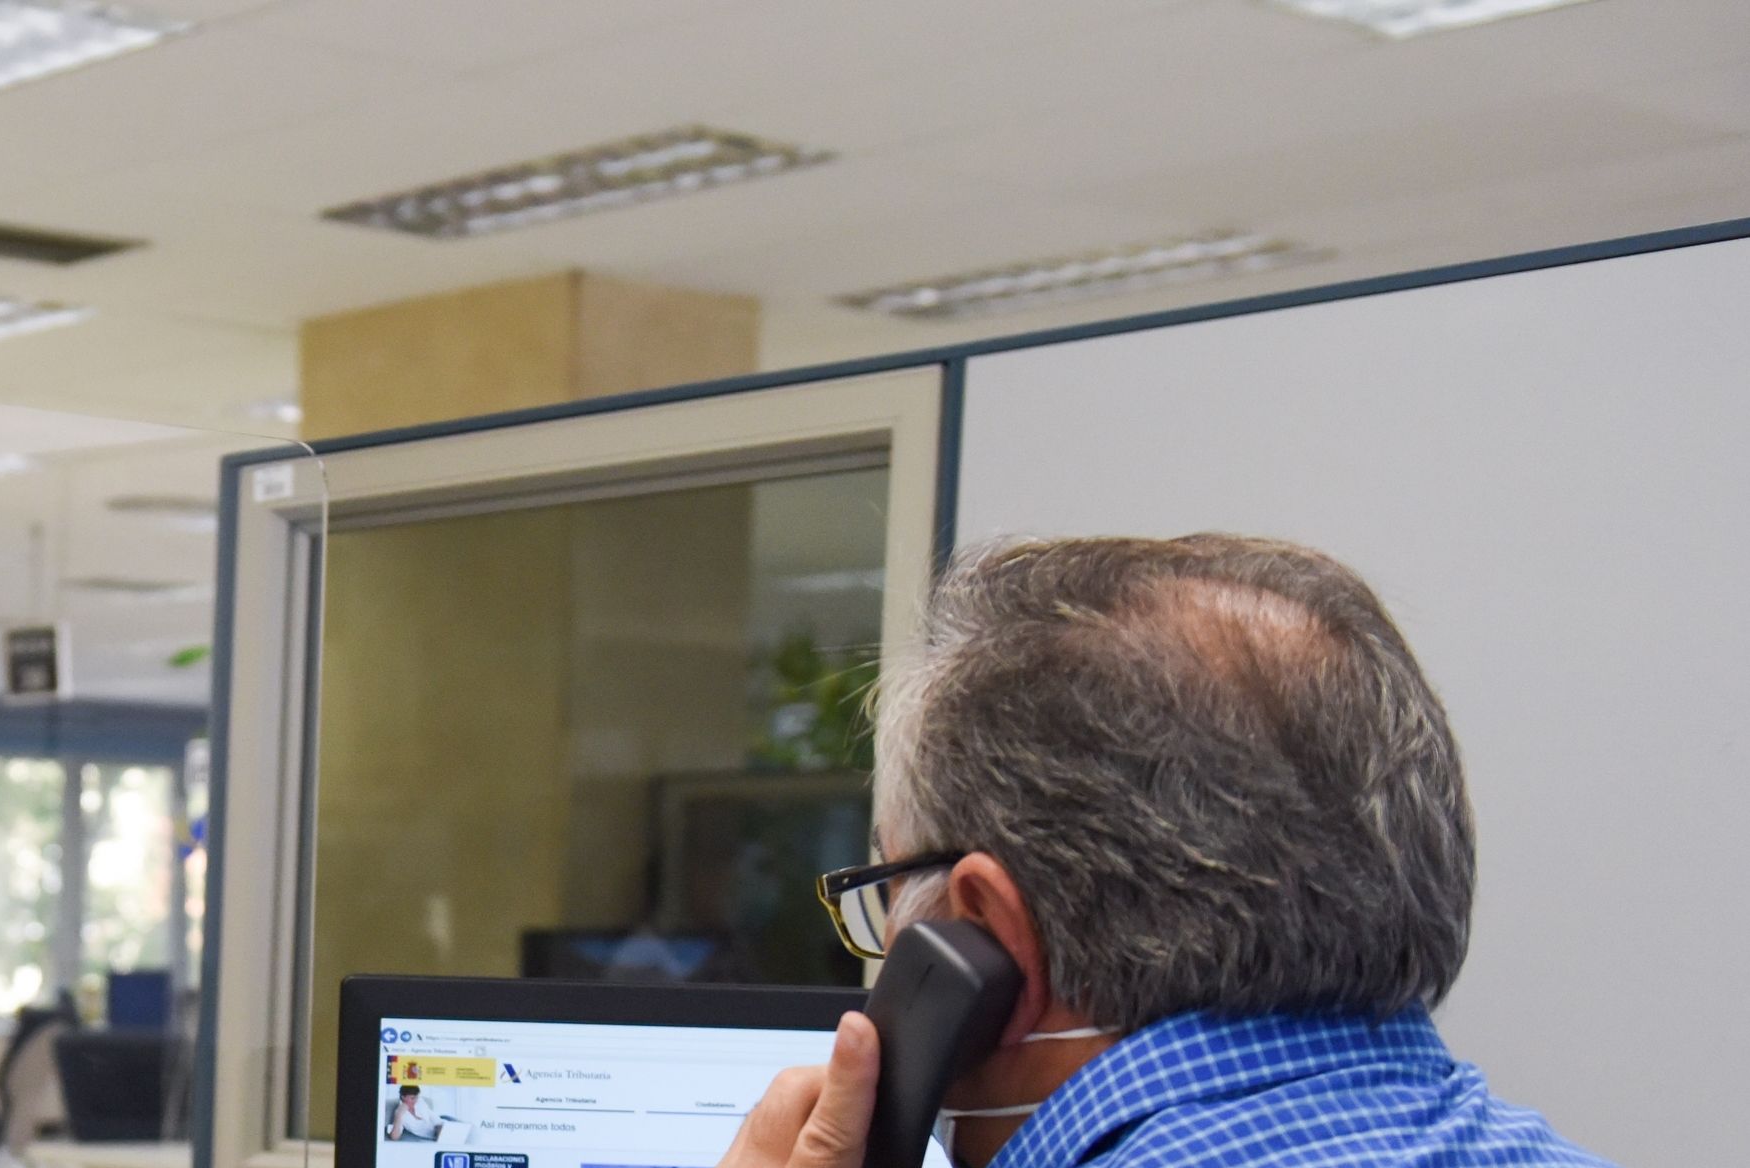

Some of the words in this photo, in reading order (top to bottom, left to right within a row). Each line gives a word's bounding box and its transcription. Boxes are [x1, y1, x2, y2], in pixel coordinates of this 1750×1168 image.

[525, 1068, 563, 1081] Agencia
[566, 1069, 612, 1081] Tributaria
[535, 1096, 563, 1104] Agencia
[498, 1121, 548, 1132] mejoramos
[551, 1121, 576, 1132] todos
